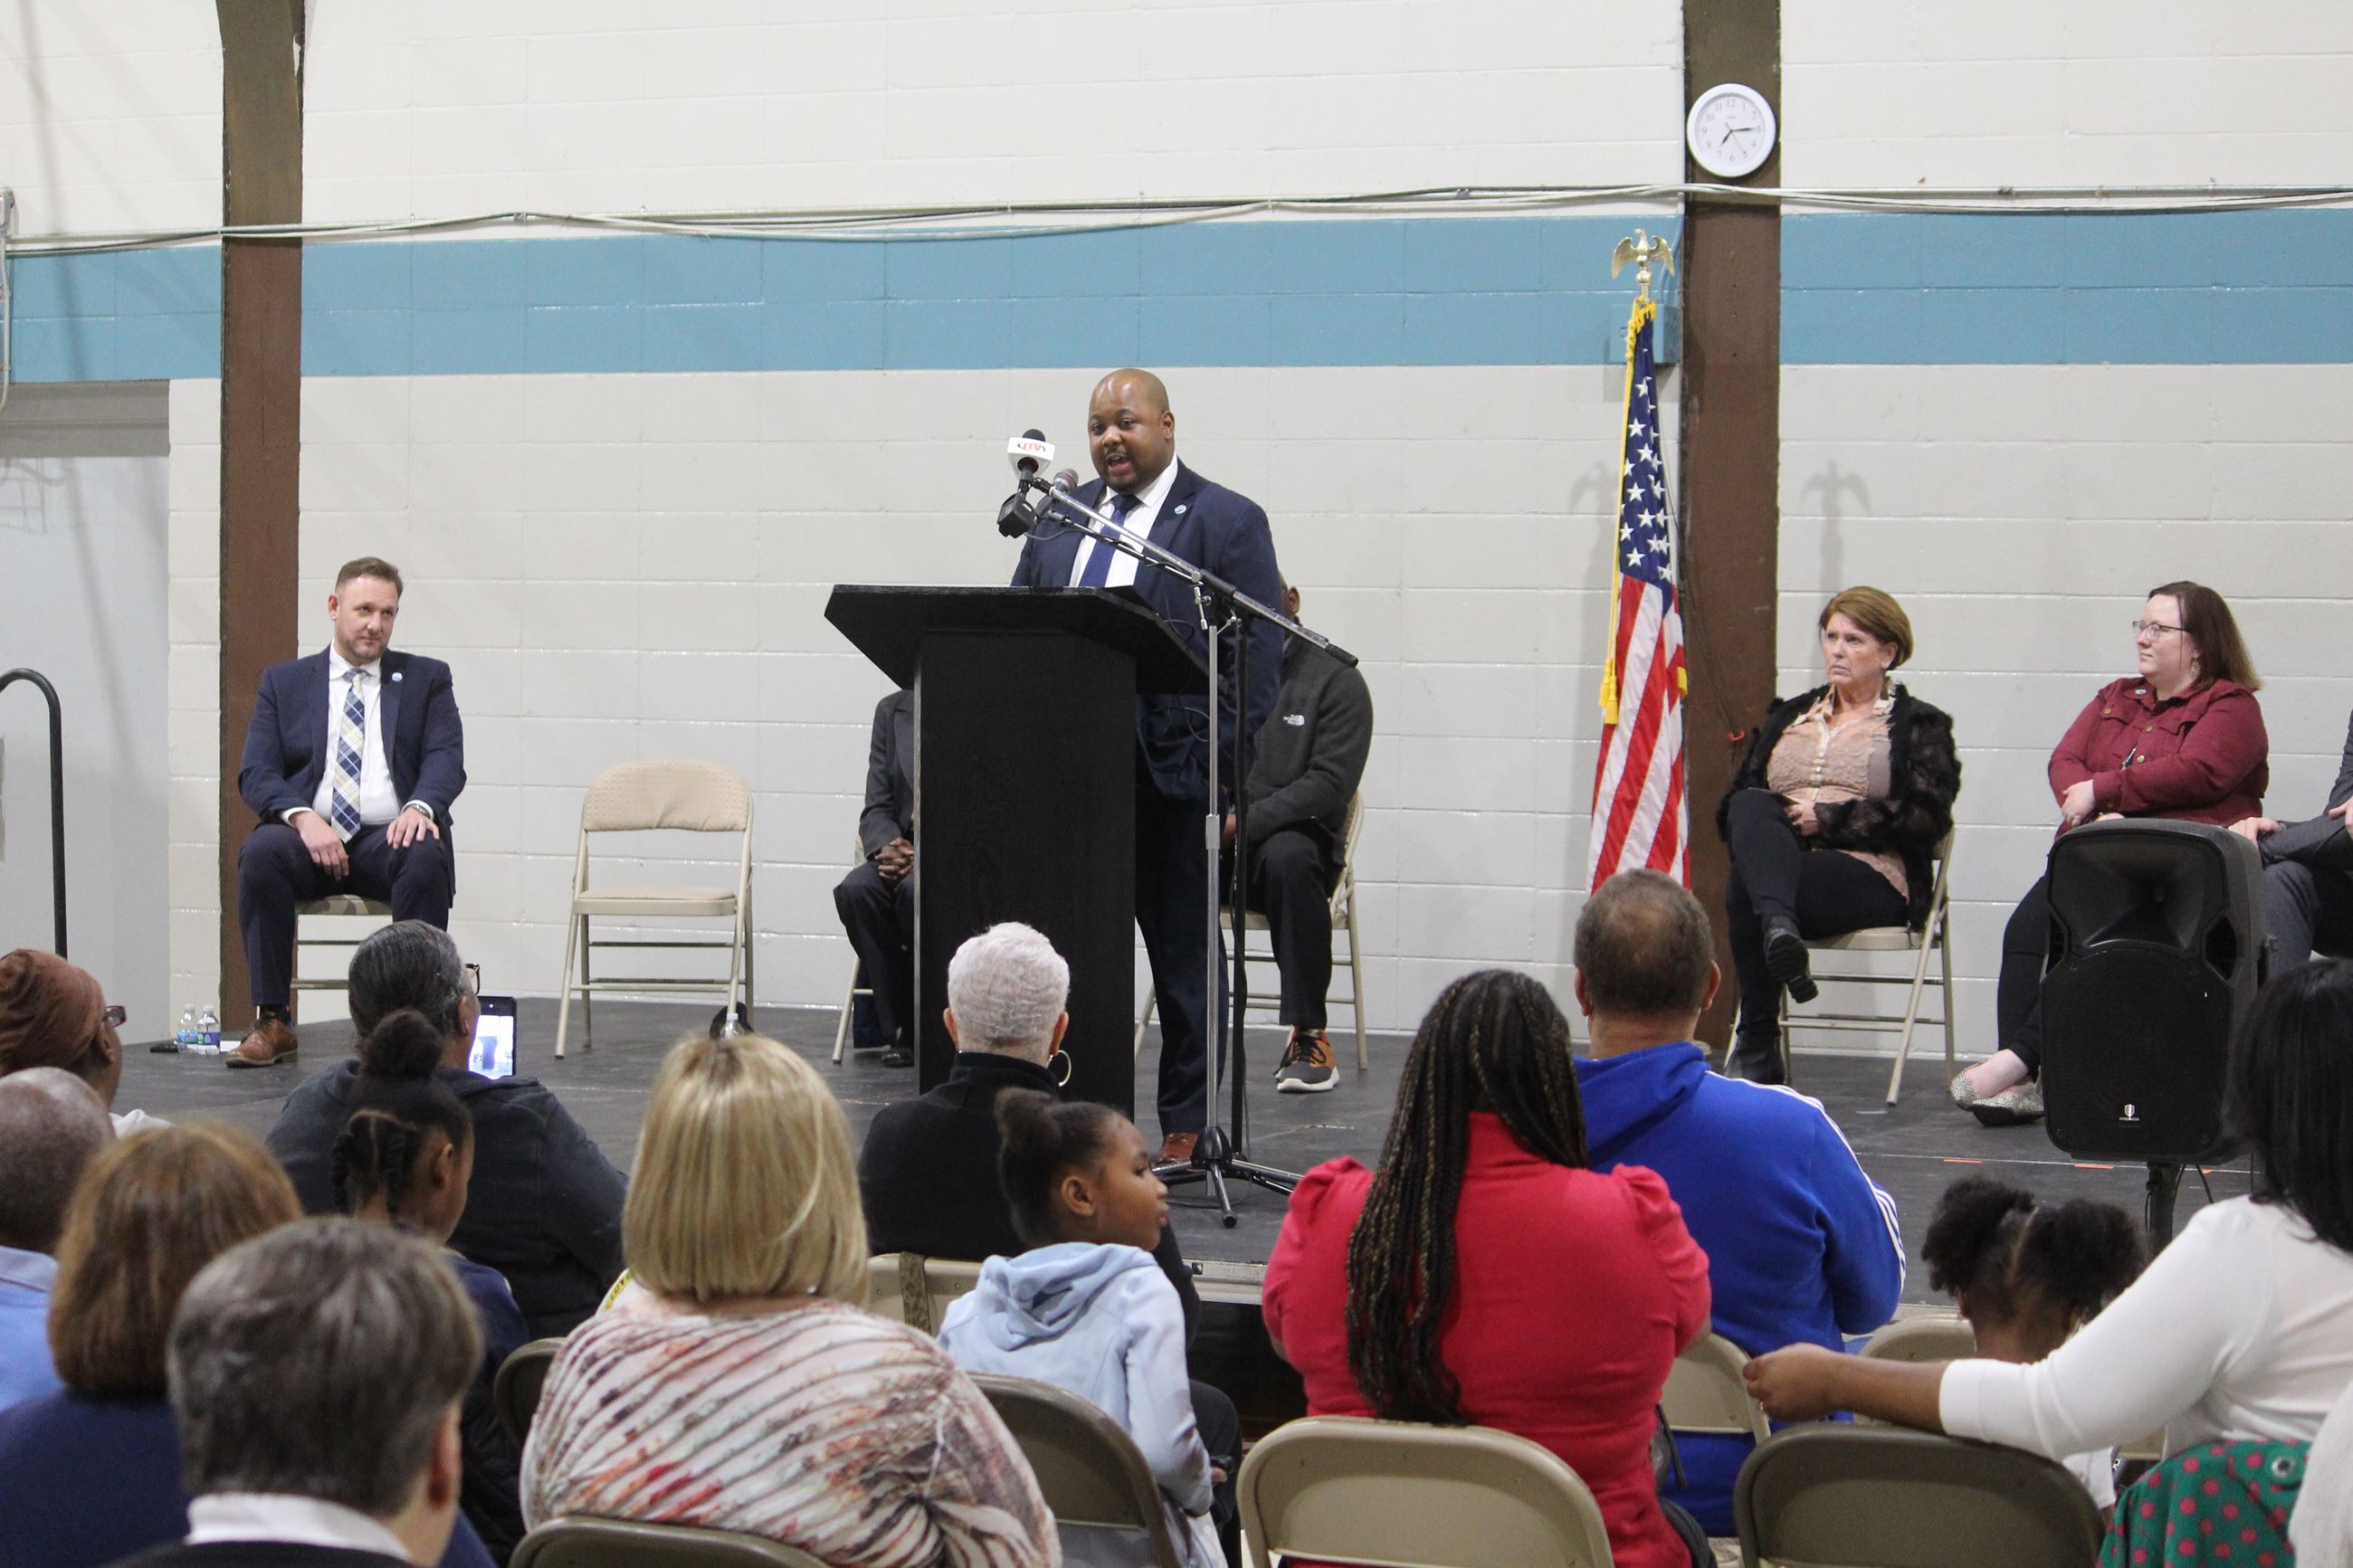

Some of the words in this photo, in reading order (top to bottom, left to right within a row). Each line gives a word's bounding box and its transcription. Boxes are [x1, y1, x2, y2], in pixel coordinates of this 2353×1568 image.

[1716, 101, 1722, 110] 11
[1727, 99, 1736, 108] 12
[1706, 112, 1715, 121] 10
